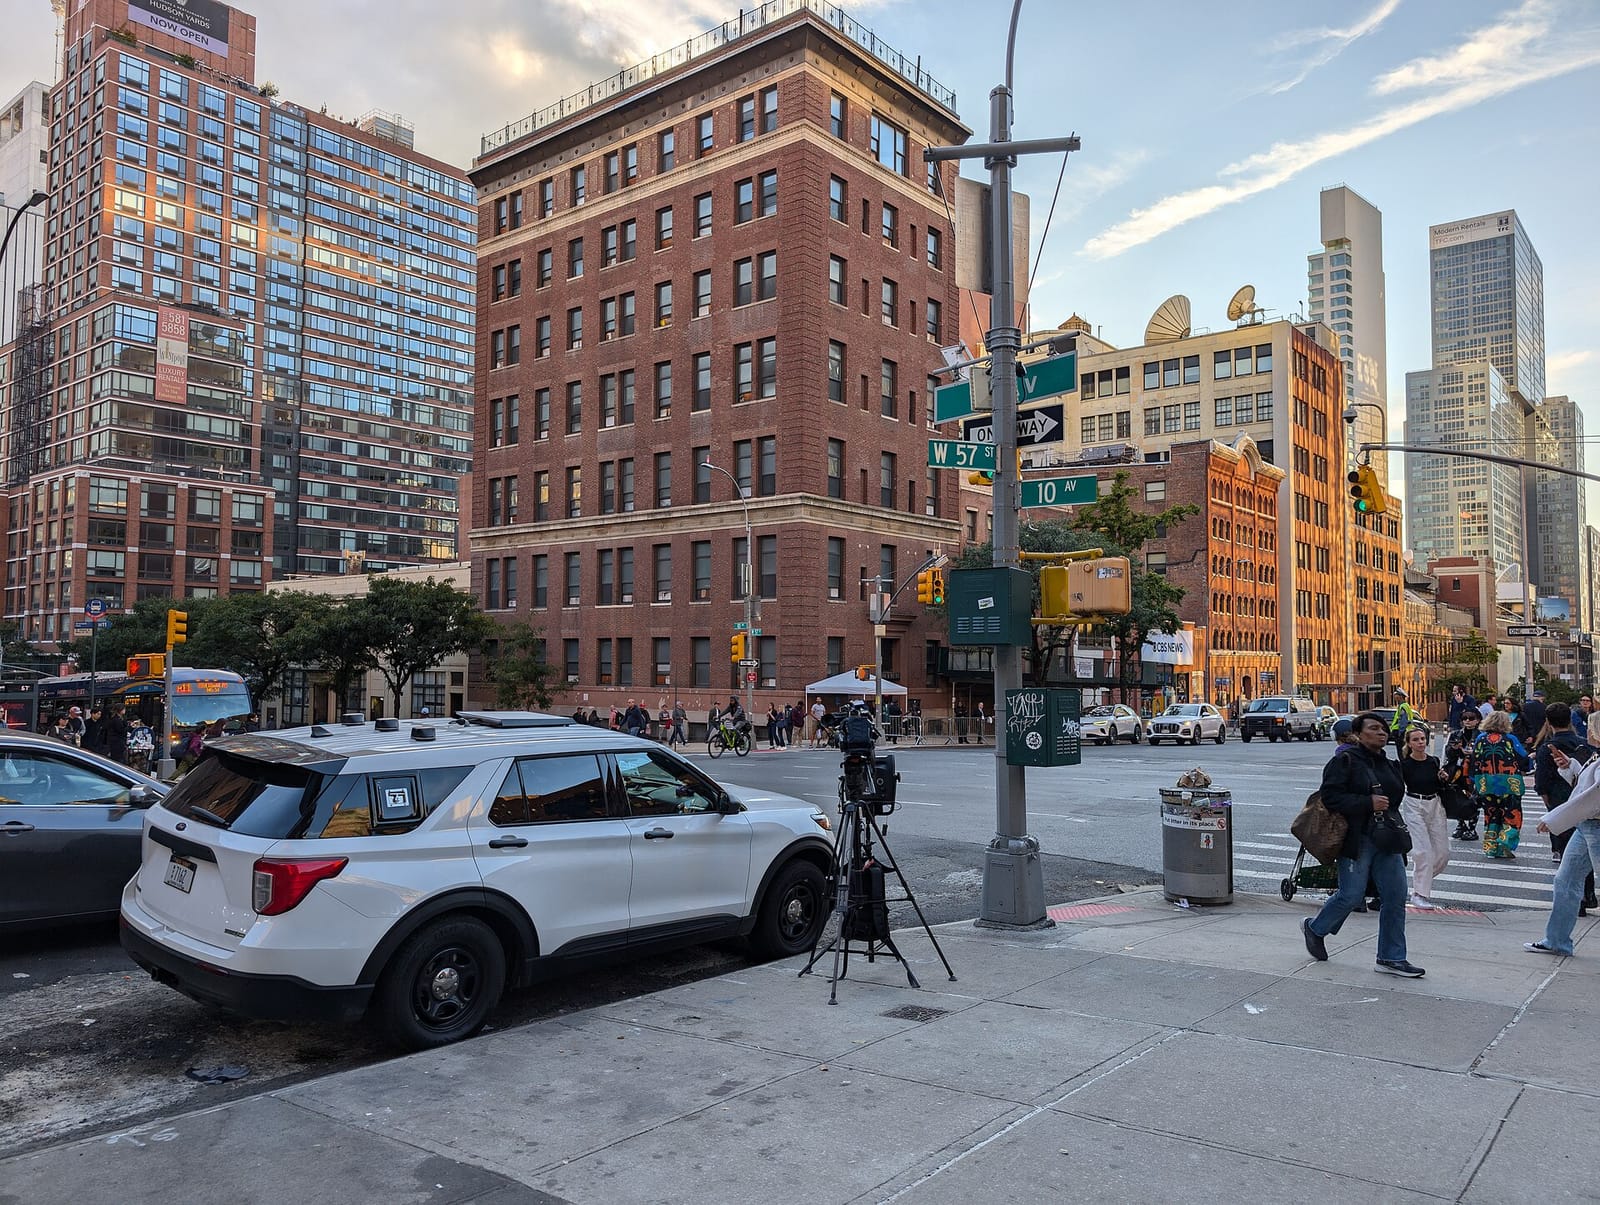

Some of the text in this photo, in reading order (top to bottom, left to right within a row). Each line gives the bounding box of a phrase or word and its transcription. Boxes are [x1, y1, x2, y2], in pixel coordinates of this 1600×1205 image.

[149, 0, 210, 29] HUDSON YARDS
[150, 15, 209, 46] NOW OPEN
[1434, 220, 1486, 235] Modern Rentals
[168, 312, 185, 325] 581
[161, 321, 186, 336] 5858
[158, 373, 185, 384] RENTALS
[159, 366, 185, 377] LUXURY
[977, 418, 1048, 441] ON WAY
[933, 442, 995, 466] W 57 ST
[1038, 480, 1077, 504] 10 AV
[1168, 642, 1184, 653] NEWS
[1198, 821, 1217, 829] place.
